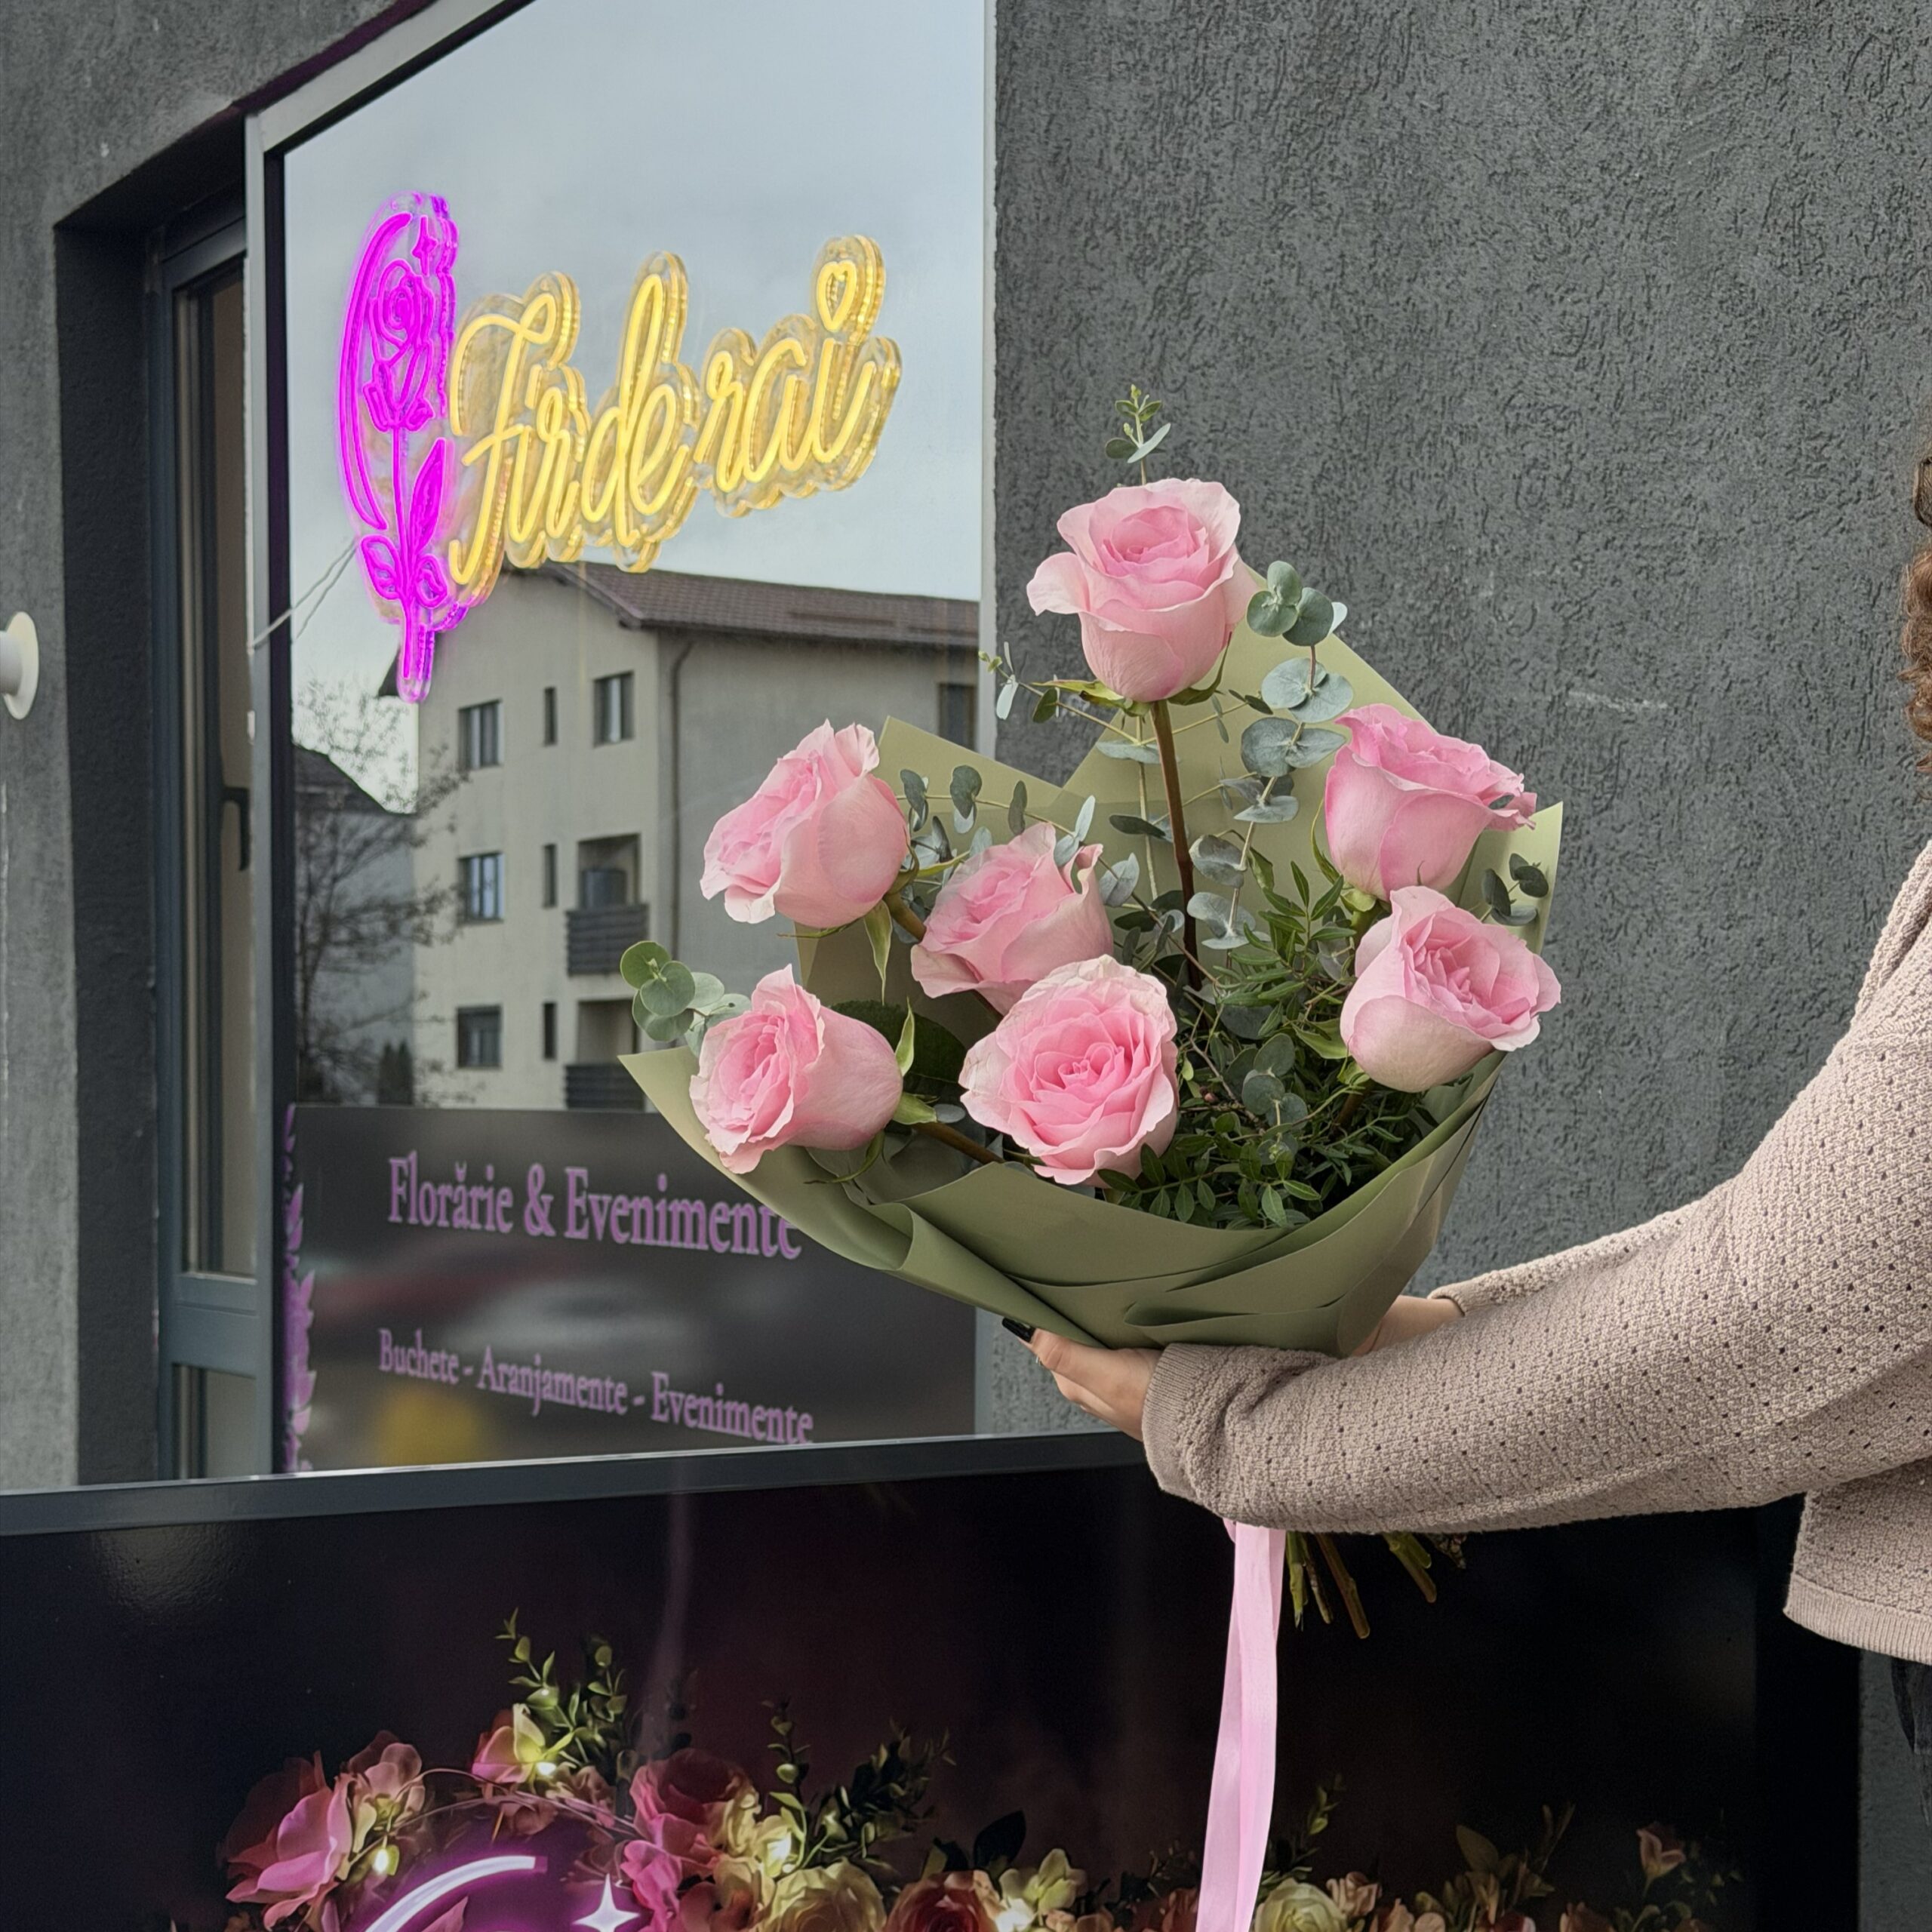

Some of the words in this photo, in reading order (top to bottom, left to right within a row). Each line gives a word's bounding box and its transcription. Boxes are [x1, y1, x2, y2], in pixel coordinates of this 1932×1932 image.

[387, 1149, 514, 1234] Florărie
[524, 1162, 557, 1237] &
[563, 1166, 803, 1260] Evenimente
[378, 1327, 460, 1386] Buchete
[463, 1365, 474, 1377] -
[475, 1345, 629, 1417] Aranjamente
[632, 1395, 645, 1407] -
[651, 1371, 814, 1444] Evenimente
